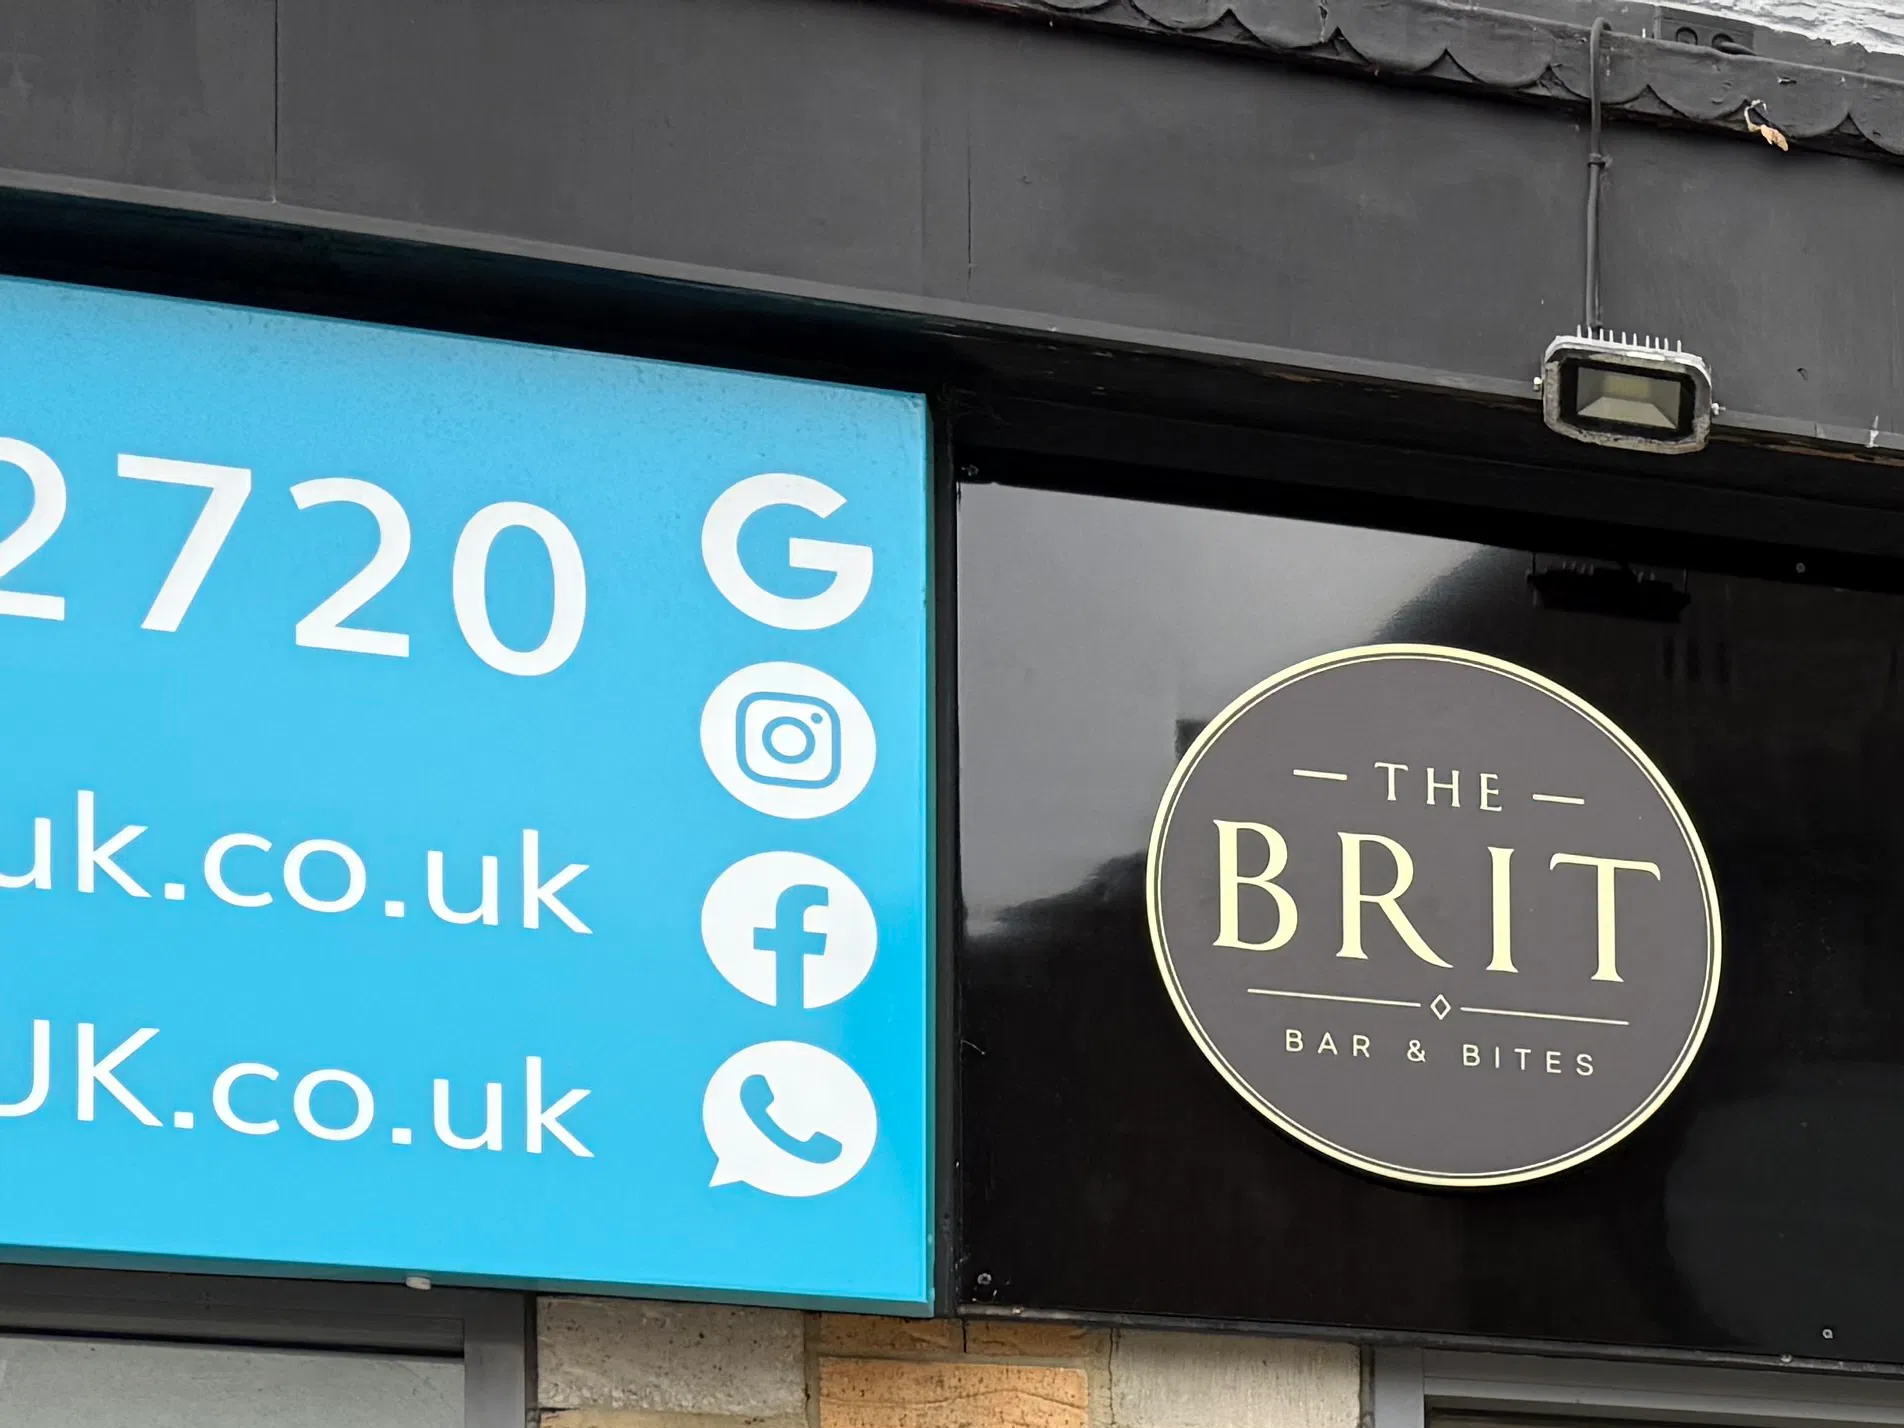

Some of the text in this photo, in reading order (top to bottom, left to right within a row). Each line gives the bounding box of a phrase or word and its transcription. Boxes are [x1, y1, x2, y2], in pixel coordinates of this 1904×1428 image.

[1374, 761, 1502, 812] THE
[1212, 818, 1661, 983] BRIT
[1285, 1029, 1595, 1076] BAR & BITES
